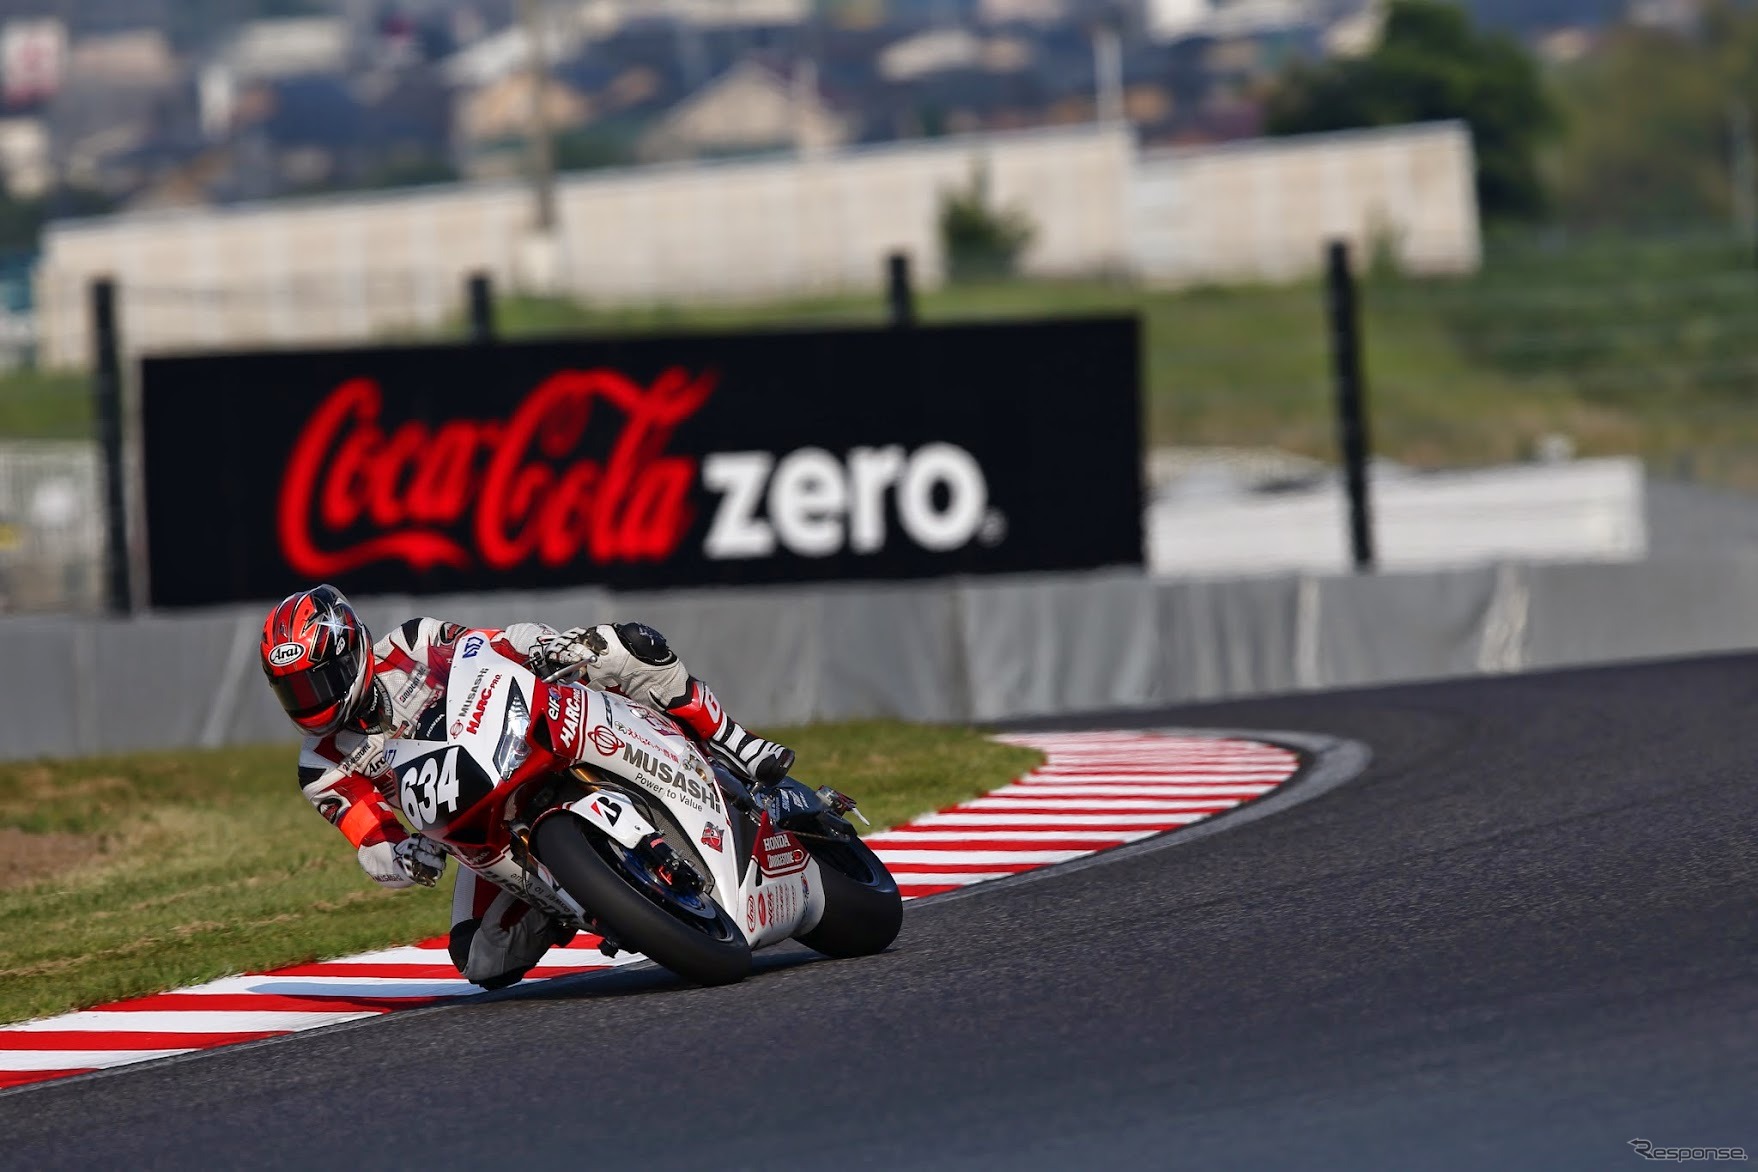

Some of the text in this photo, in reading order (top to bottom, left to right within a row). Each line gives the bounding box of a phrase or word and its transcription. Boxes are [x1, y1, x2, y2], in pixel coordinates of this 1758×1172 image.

[702, 442, 988, 559] zero
[273, 644, 299, 661] Arai
[548, 693, 562, 721] elf
[426, 713, 446, 738] HONDA
[402, 747, 460, 831] 634
[635, 773, 703, 812] Power to Value
[763, 833, 791, 852] HONDA
